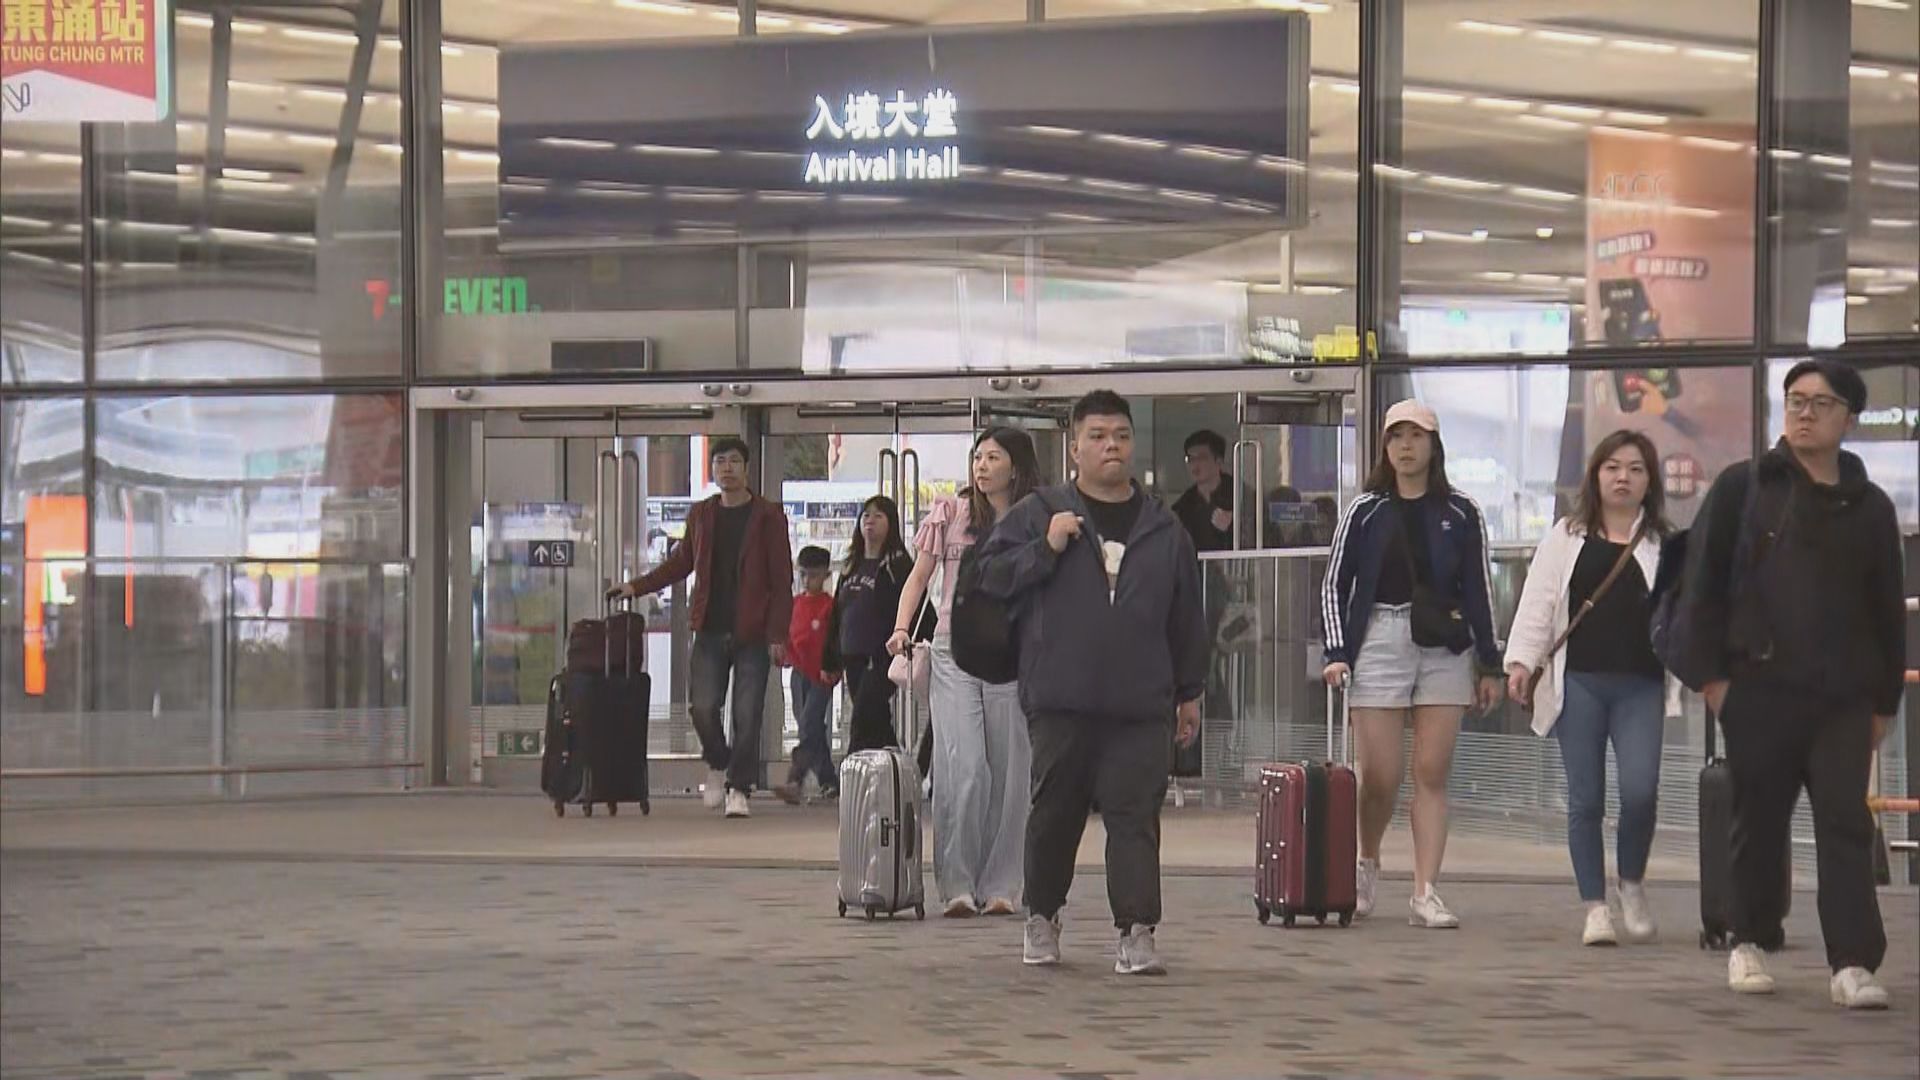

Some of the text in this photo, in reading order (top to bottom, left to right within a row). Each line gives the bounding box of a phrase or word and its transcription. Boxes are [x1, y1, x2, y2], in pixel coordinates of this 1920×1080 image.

[1, 46, 144, 64] TUNG CHUNG MTR
[806, 88, 957, 139] 入境大堂
[804, 146, 959, 183] Arrival Hall
